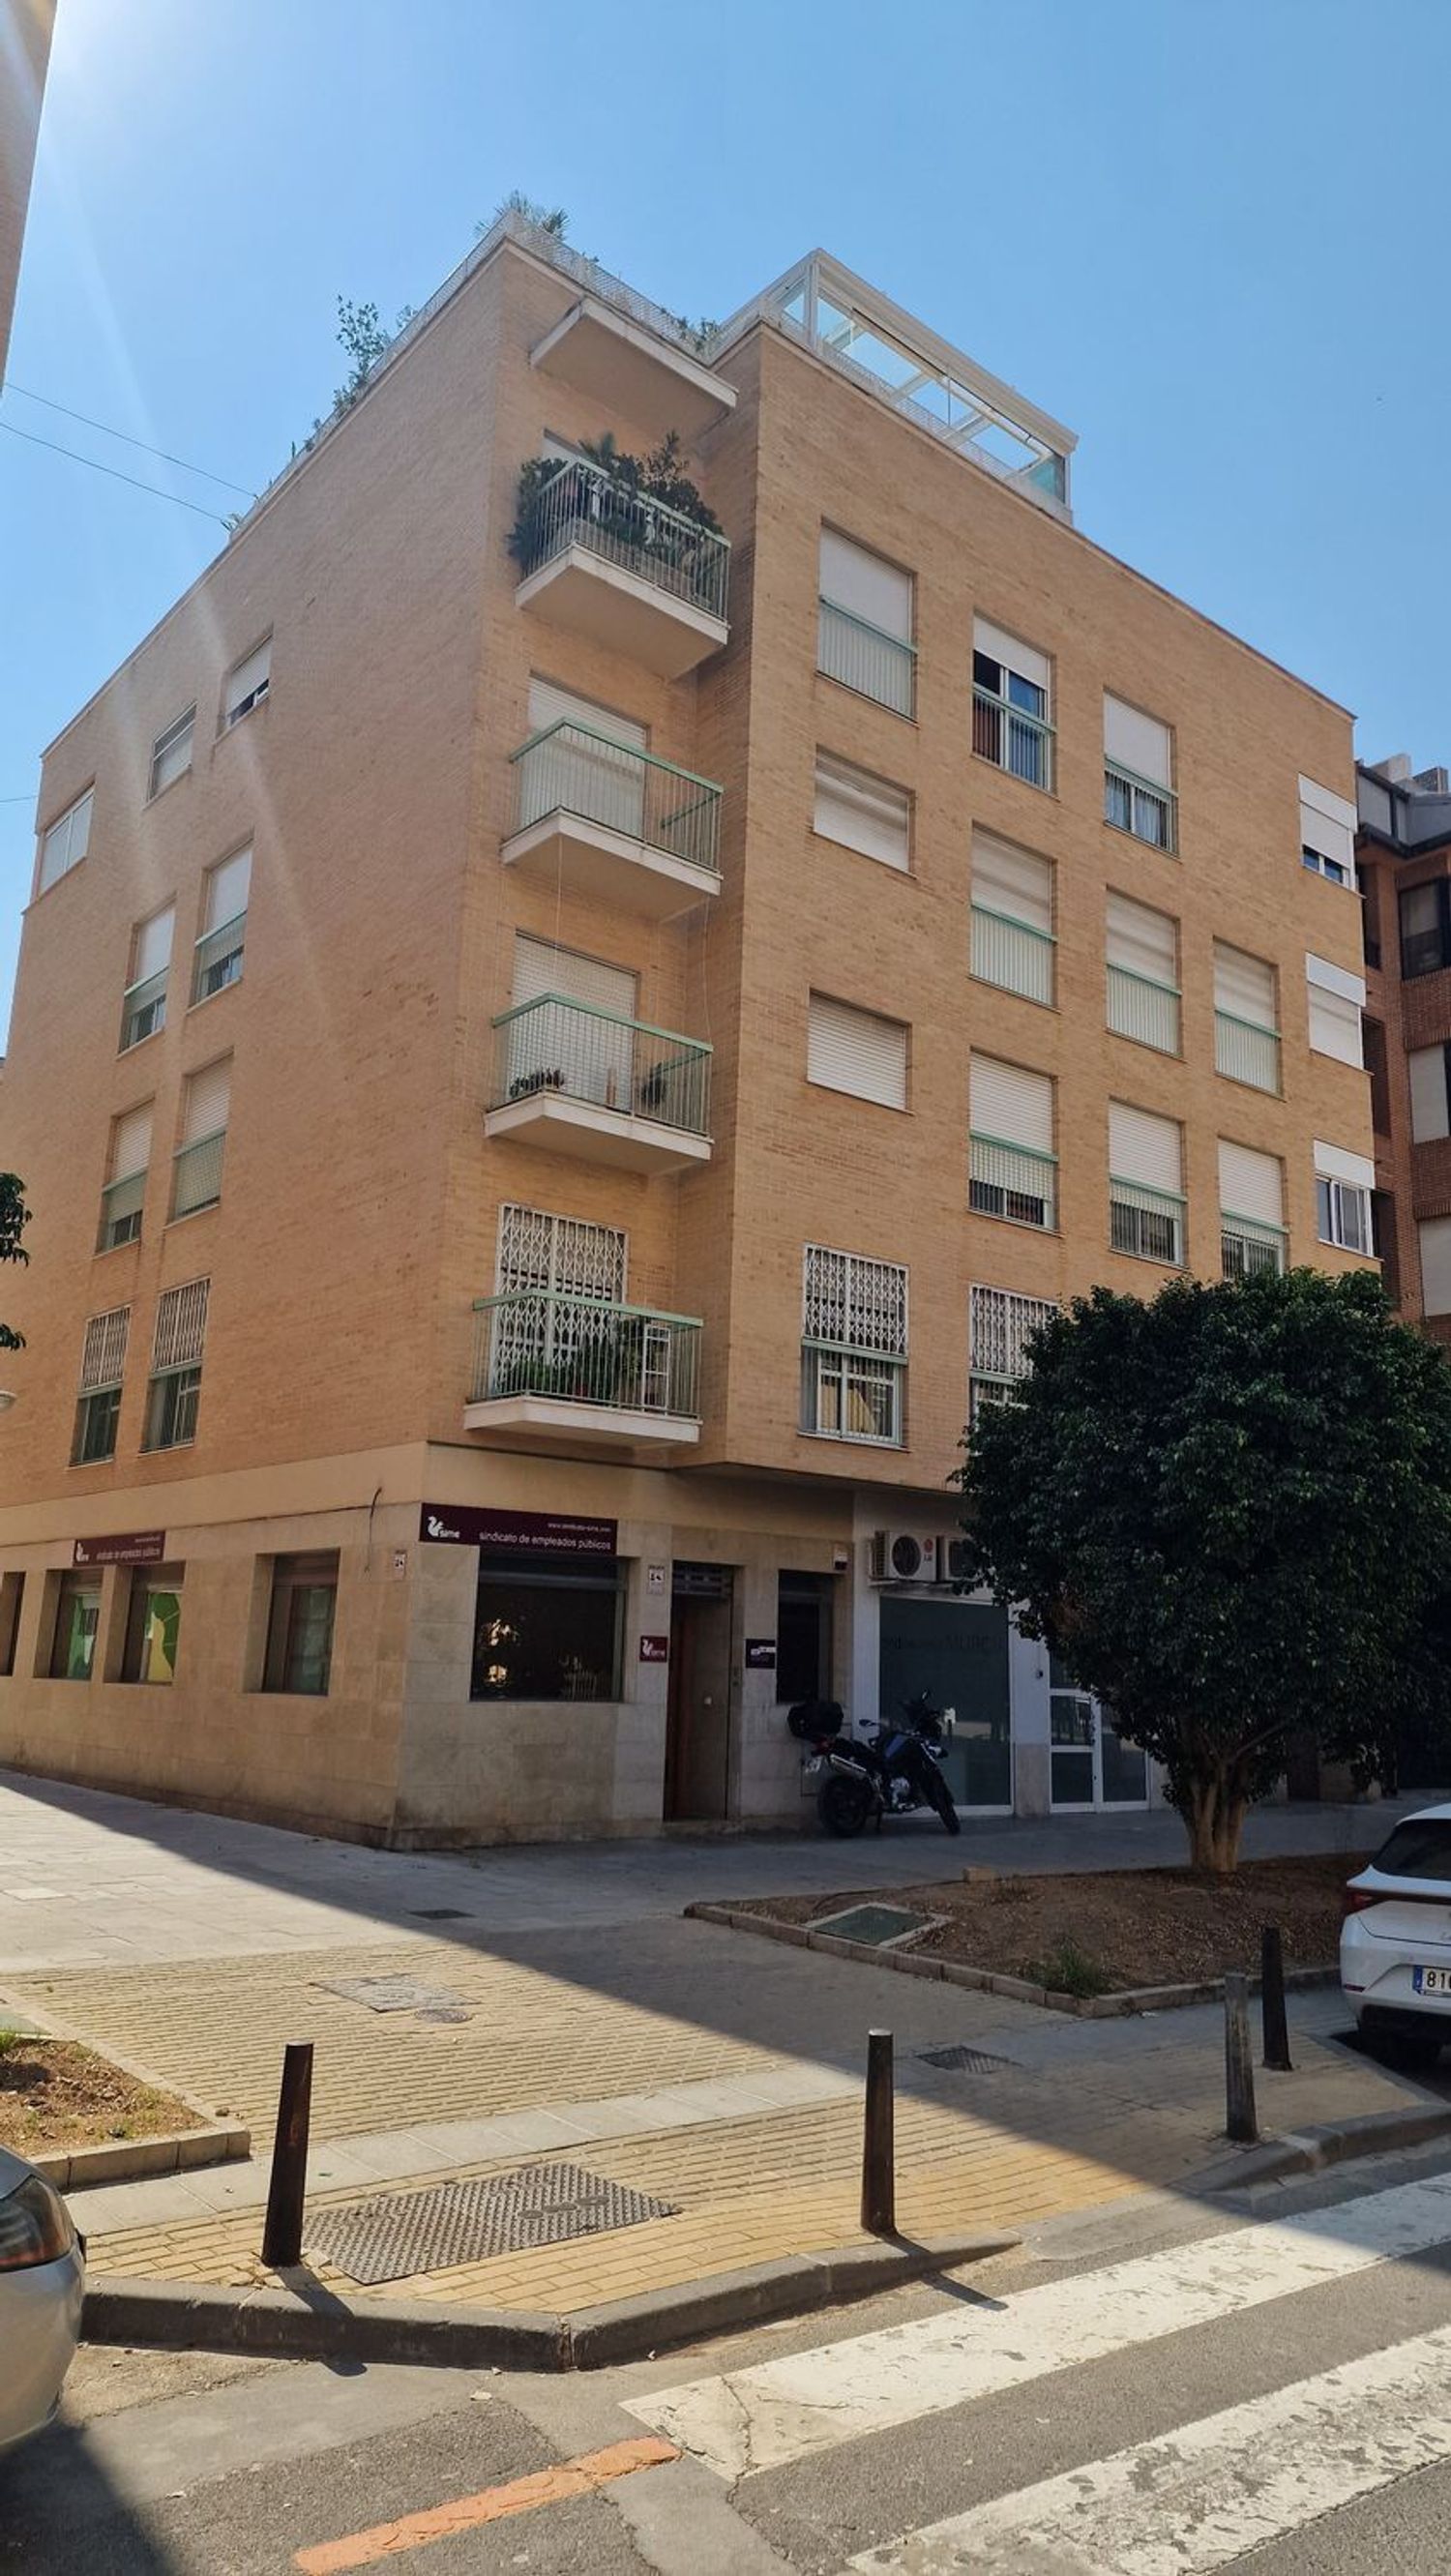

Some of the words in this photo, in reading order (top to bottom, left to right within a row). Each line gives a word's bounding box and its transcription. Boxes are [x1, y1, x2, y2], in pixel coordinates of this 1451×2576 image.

[479, 1531, 518, 1543] sindicato
[518, 1533, 529, 1543] de
[531, 1536, 577, 1548] empleados
[1427, 1970, 1451, 1989] 81
